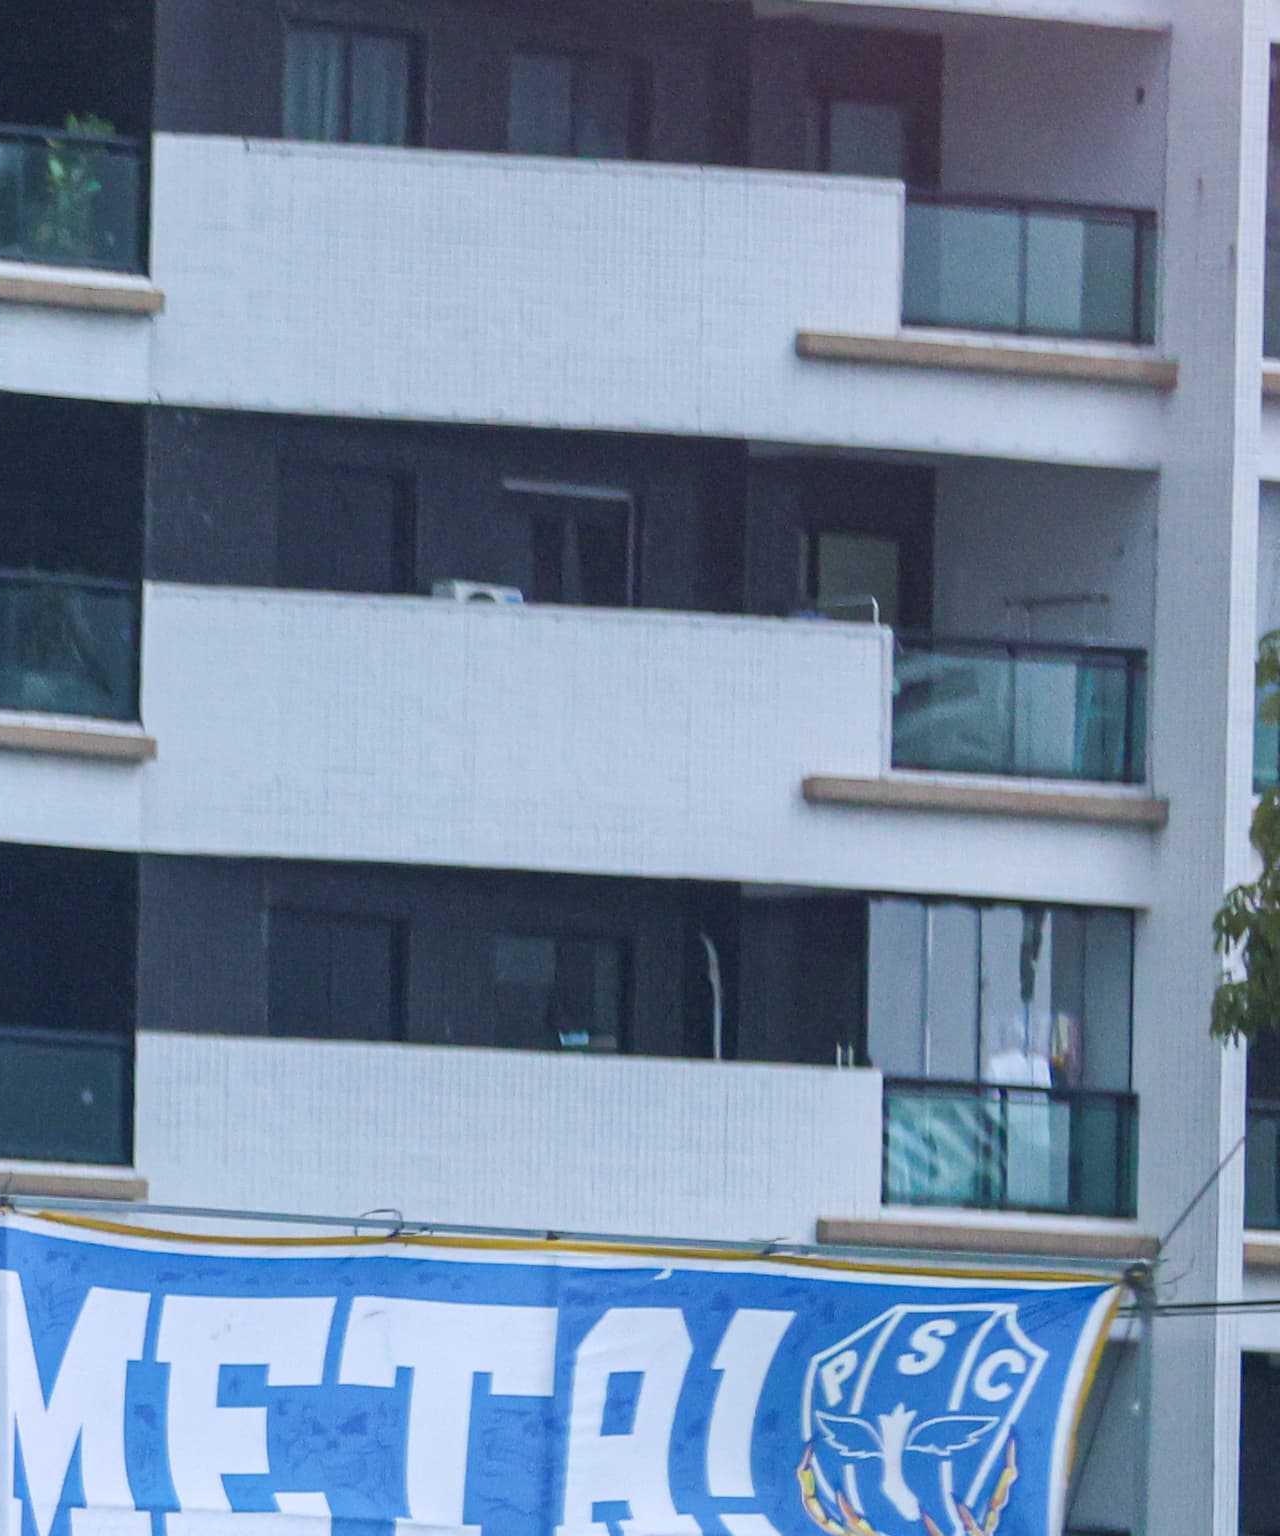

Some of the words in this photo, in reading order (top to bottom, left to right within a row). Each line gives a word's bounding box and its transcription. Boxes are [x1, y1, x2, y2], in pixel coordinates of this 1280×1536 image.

[820, 1349, 858, 1408] P
[897, 1318, 957, 1376] S
[972, 1348, 1026, 1402] C
